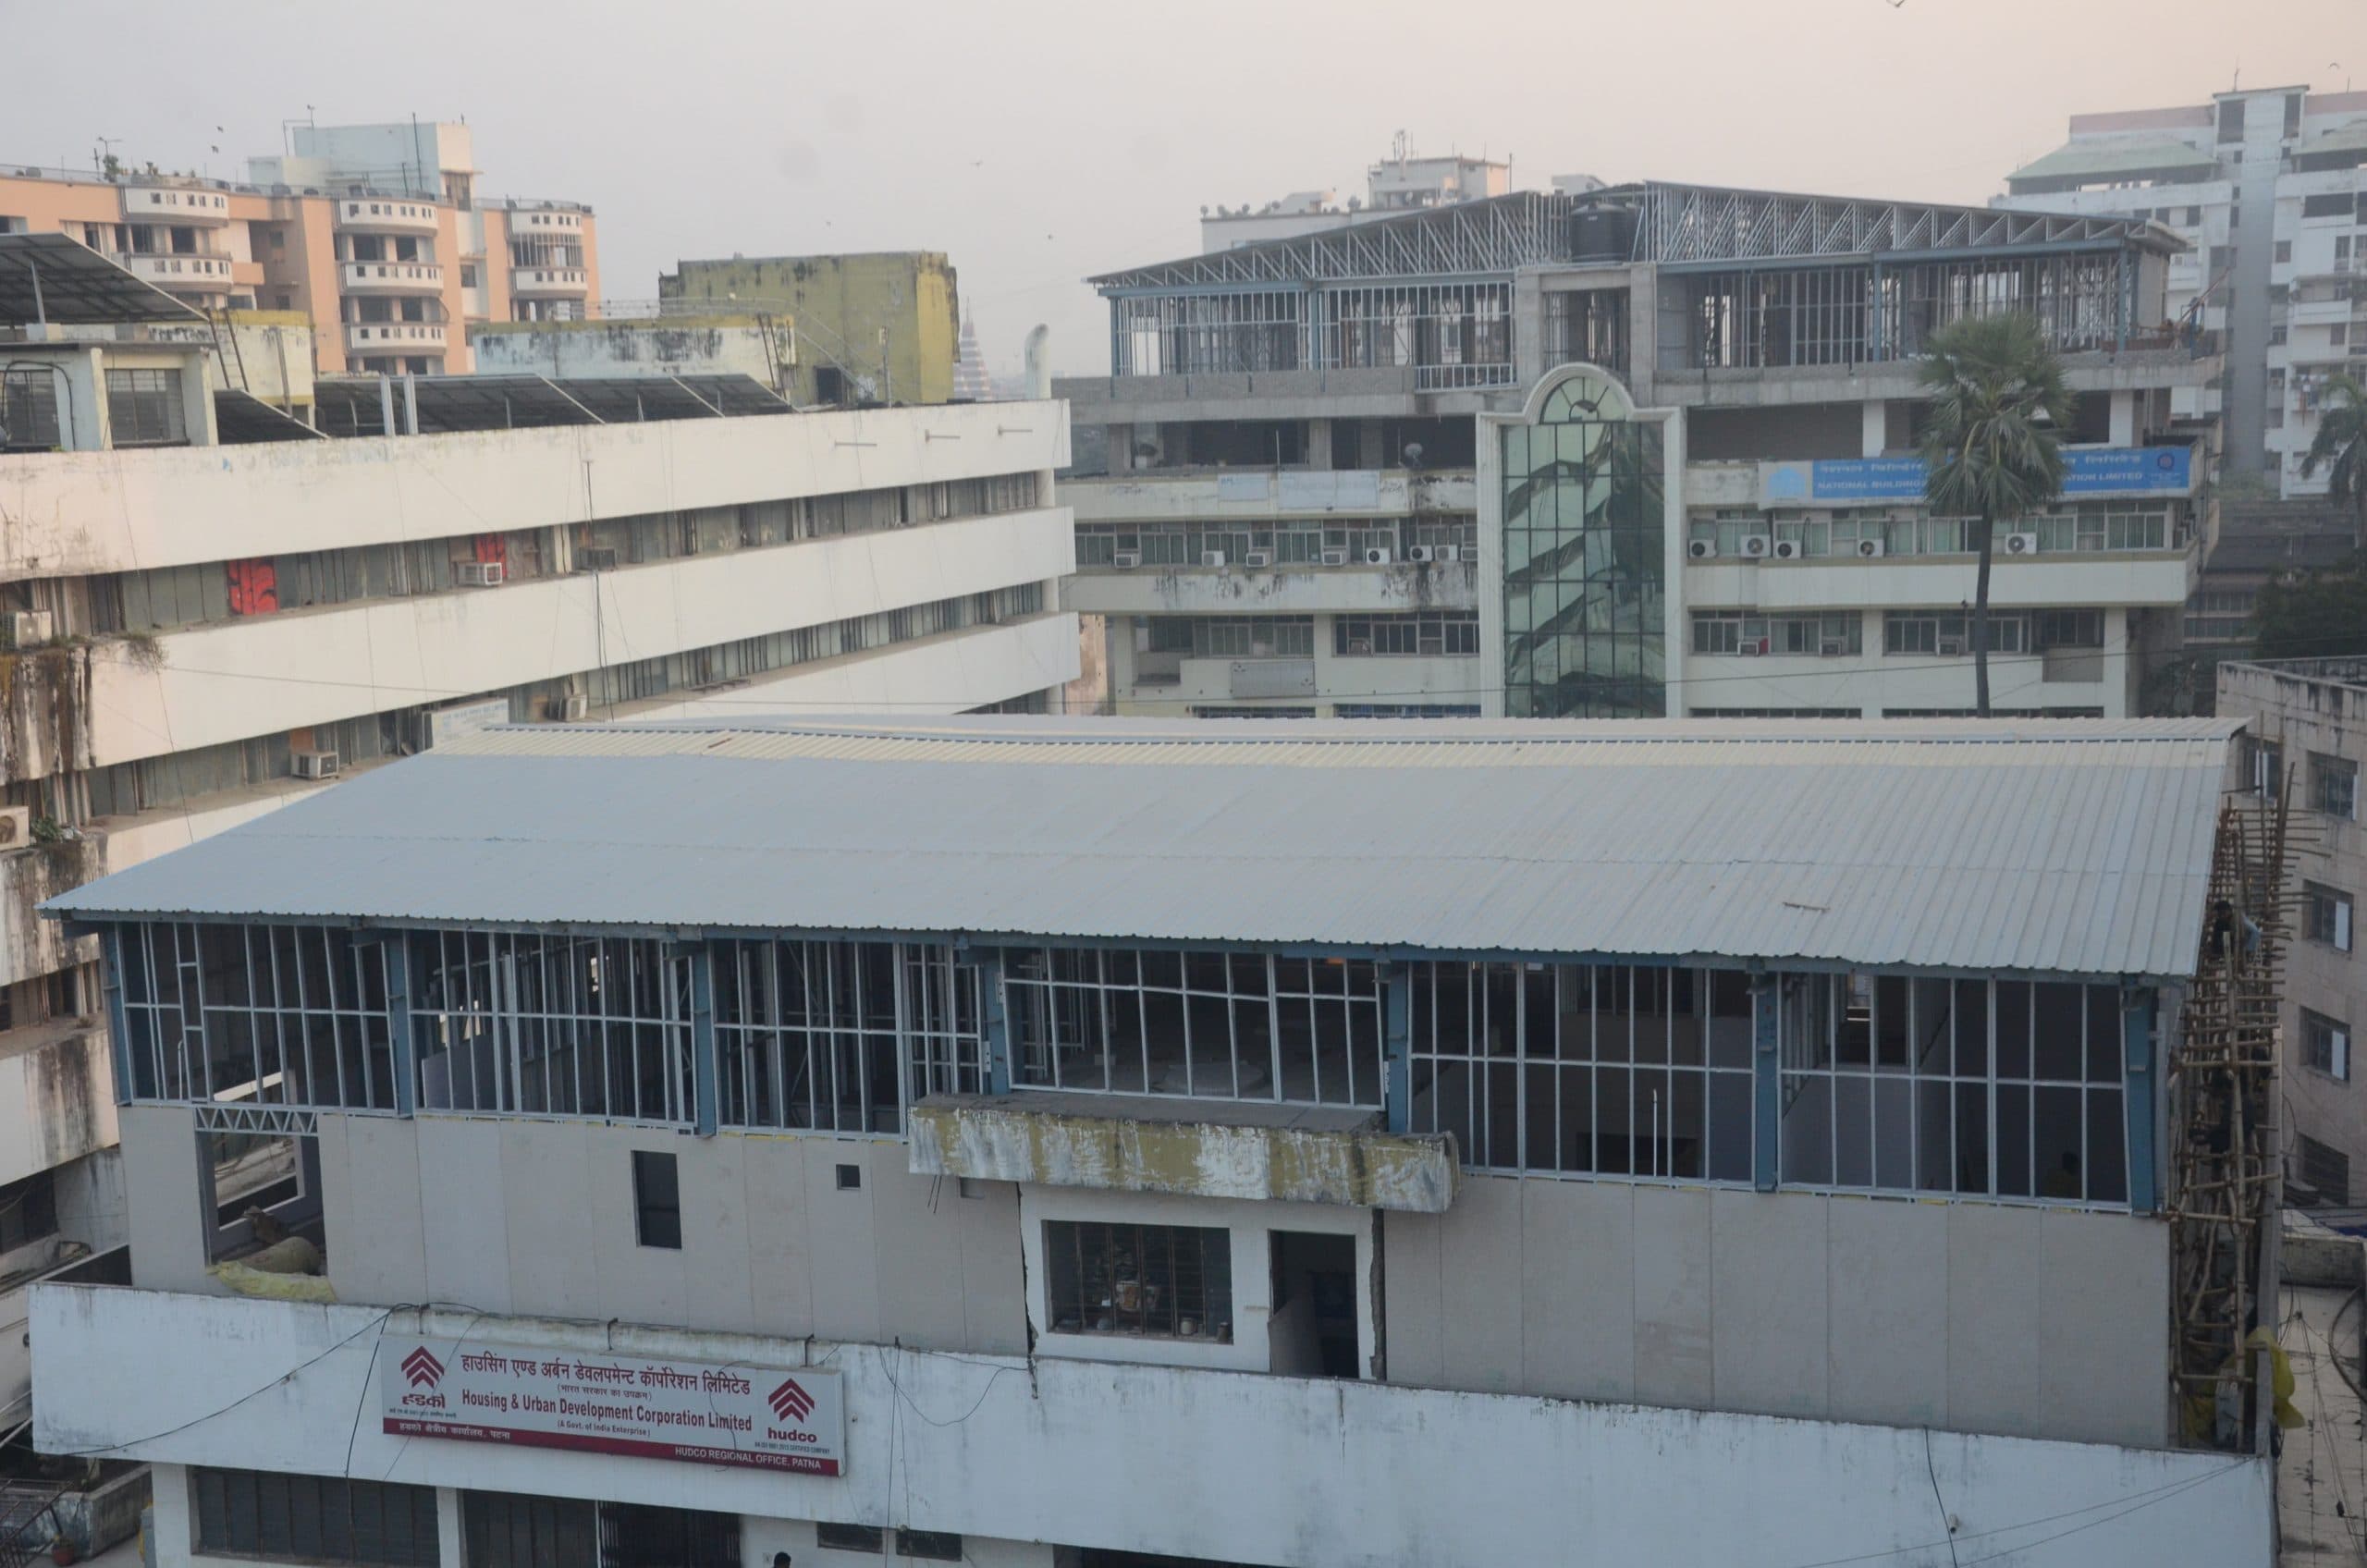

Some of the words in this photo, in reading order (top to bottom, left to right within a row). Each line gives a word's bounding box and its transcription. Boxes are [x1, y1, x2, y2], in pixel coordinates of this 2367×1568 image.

[1818, 480, 1867, 489] NATIONAL
[2099, 472, 2143, 482] LIMITED
[460, 1351, 507, 1374] हाउसिंग
[510, 1359, 536, 1378] एण्ड
[541, 1357, 570, 1378] अर्बन
[574, 1359, 634, 1384] डेवलपमेन्ट
[703, 1369, 750, 1395] लिमिटेड
[582, 1386, 607, 1395] सरकार
[610, 1389, 620, 1397] का
[462, 1389, 507, 1413] Housing
[511, 1393, 519, 1409] &
[523, 1394, 556, 1414] Urban
[559, 1398, 632, 1421] Development
[637, 1405, 705, 1427] Corporation
[709, 1412, 752, 1431] Limited
[595, 1423, 610, 1431] India
[612, 1426, 650, 1437] Enterprise)
[767, 1427, 817, 1443] hudco
[675, 1447, 706, 1458] HUDCO
[709, 1450, 754, 1463] REGIONAL
[755, 1454, 791, 1466] OFFICE,
[792, 1457, 821, 1470] PATNA
